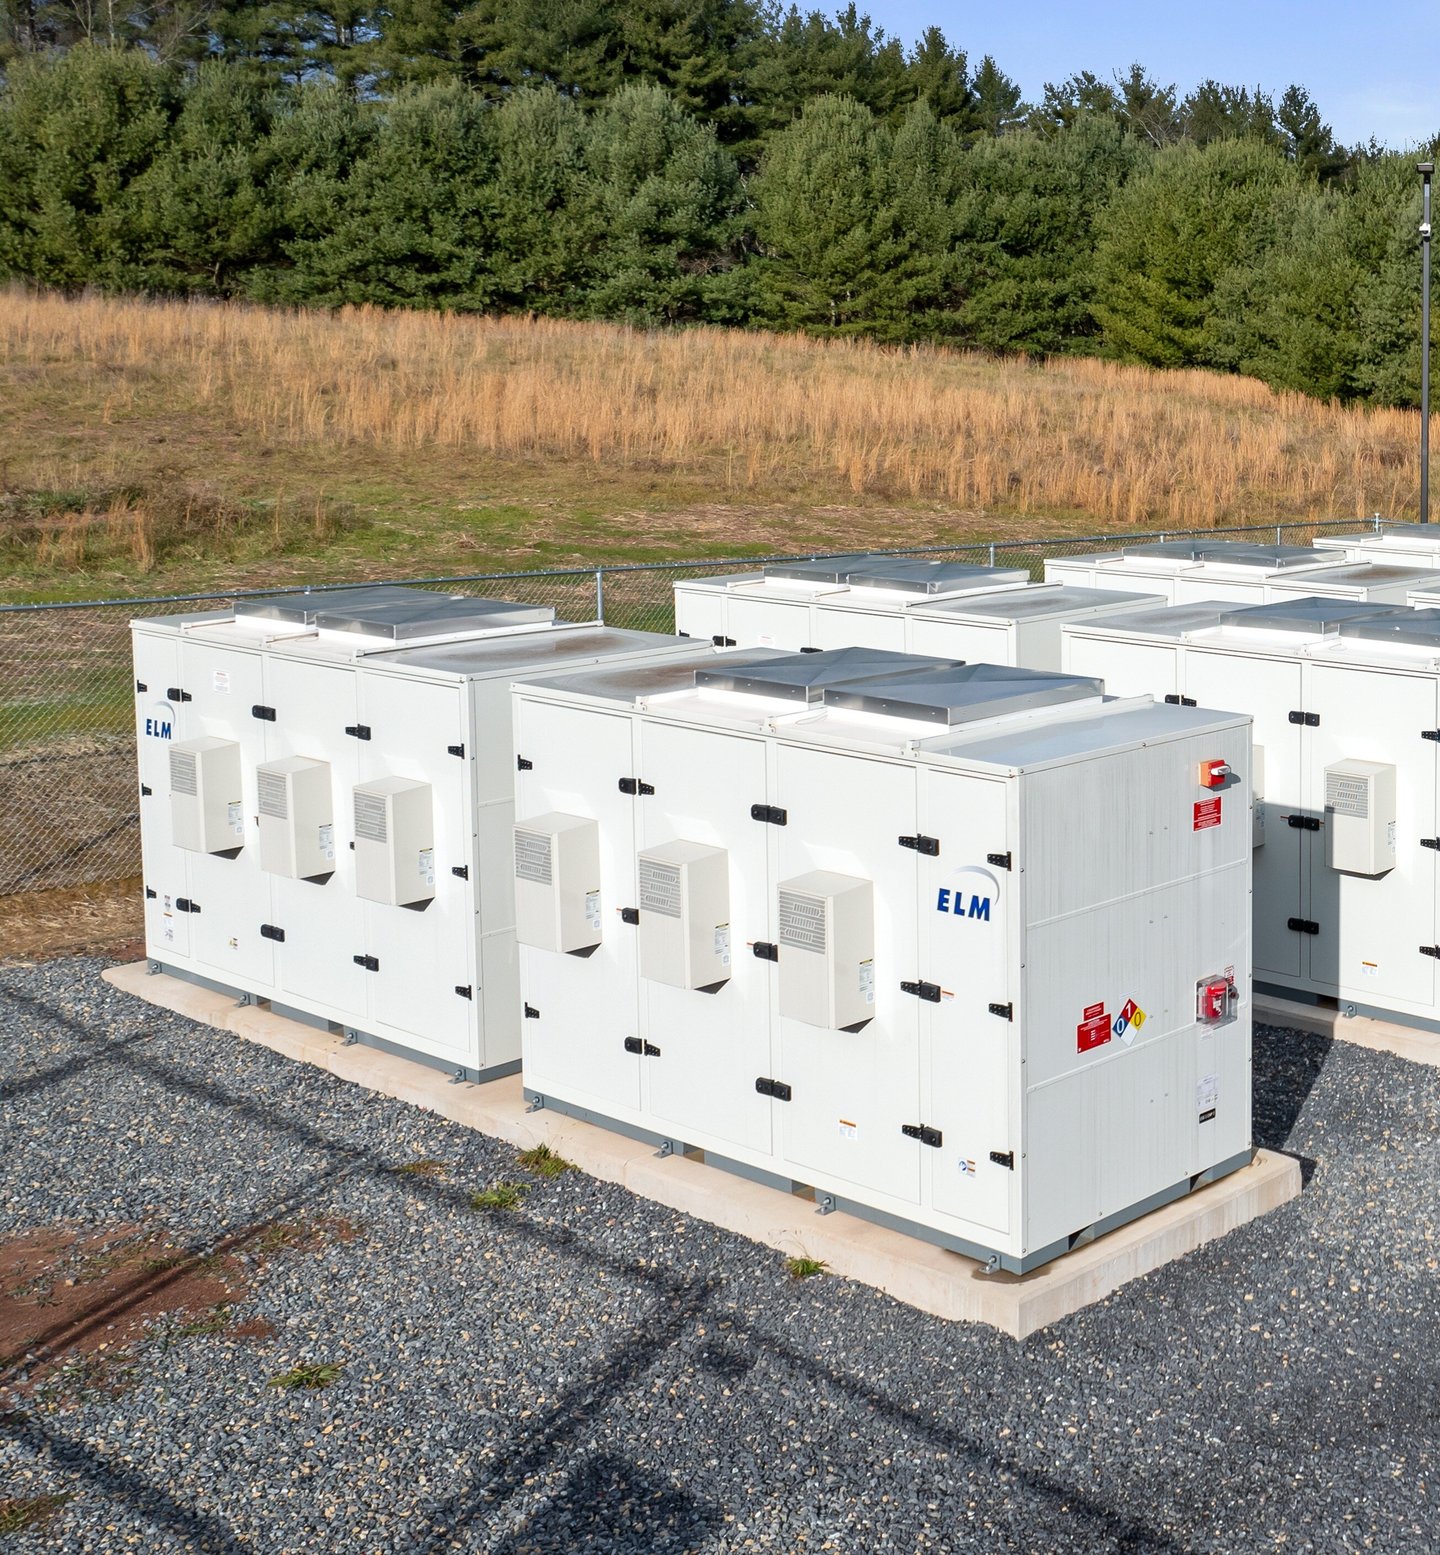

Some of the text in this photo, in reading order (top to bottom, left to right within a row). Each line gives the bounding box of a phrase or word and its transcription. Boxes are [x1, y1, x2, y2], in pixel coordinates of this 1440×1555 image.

[146, 718, 172, 740] ELM
[937, 888, 990, 921] ELM
[1125, 1002, 1132, 1018] 1
[1116, 1018, 1125, 1034] 0
[1134, 1011, 1142, 1027] 0
